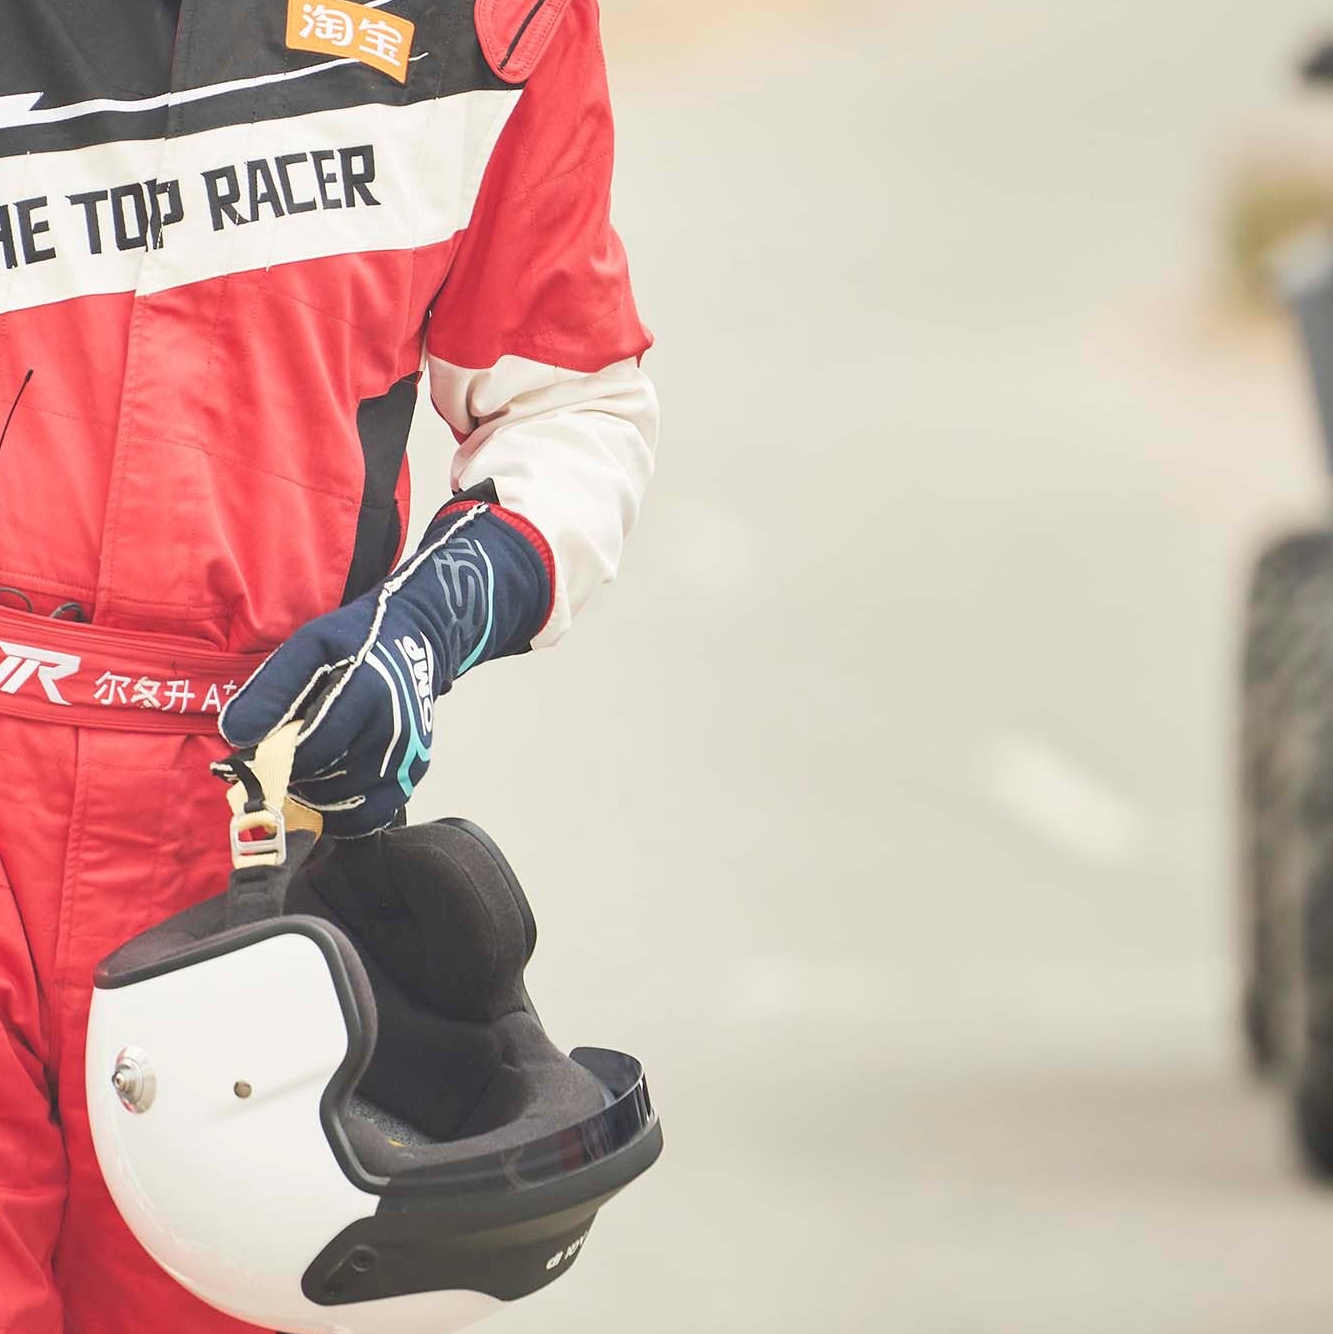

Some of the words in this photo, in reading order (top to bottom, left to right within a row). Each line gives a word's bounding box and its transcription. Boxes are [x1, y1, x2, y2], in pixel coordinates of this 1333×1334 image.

[298, 3, 403, 67] 淘宝
[66, 177, 185, 255] TOP
[200, 144, 382, 232] RACER
[402, 635, 433, 734] OMP
